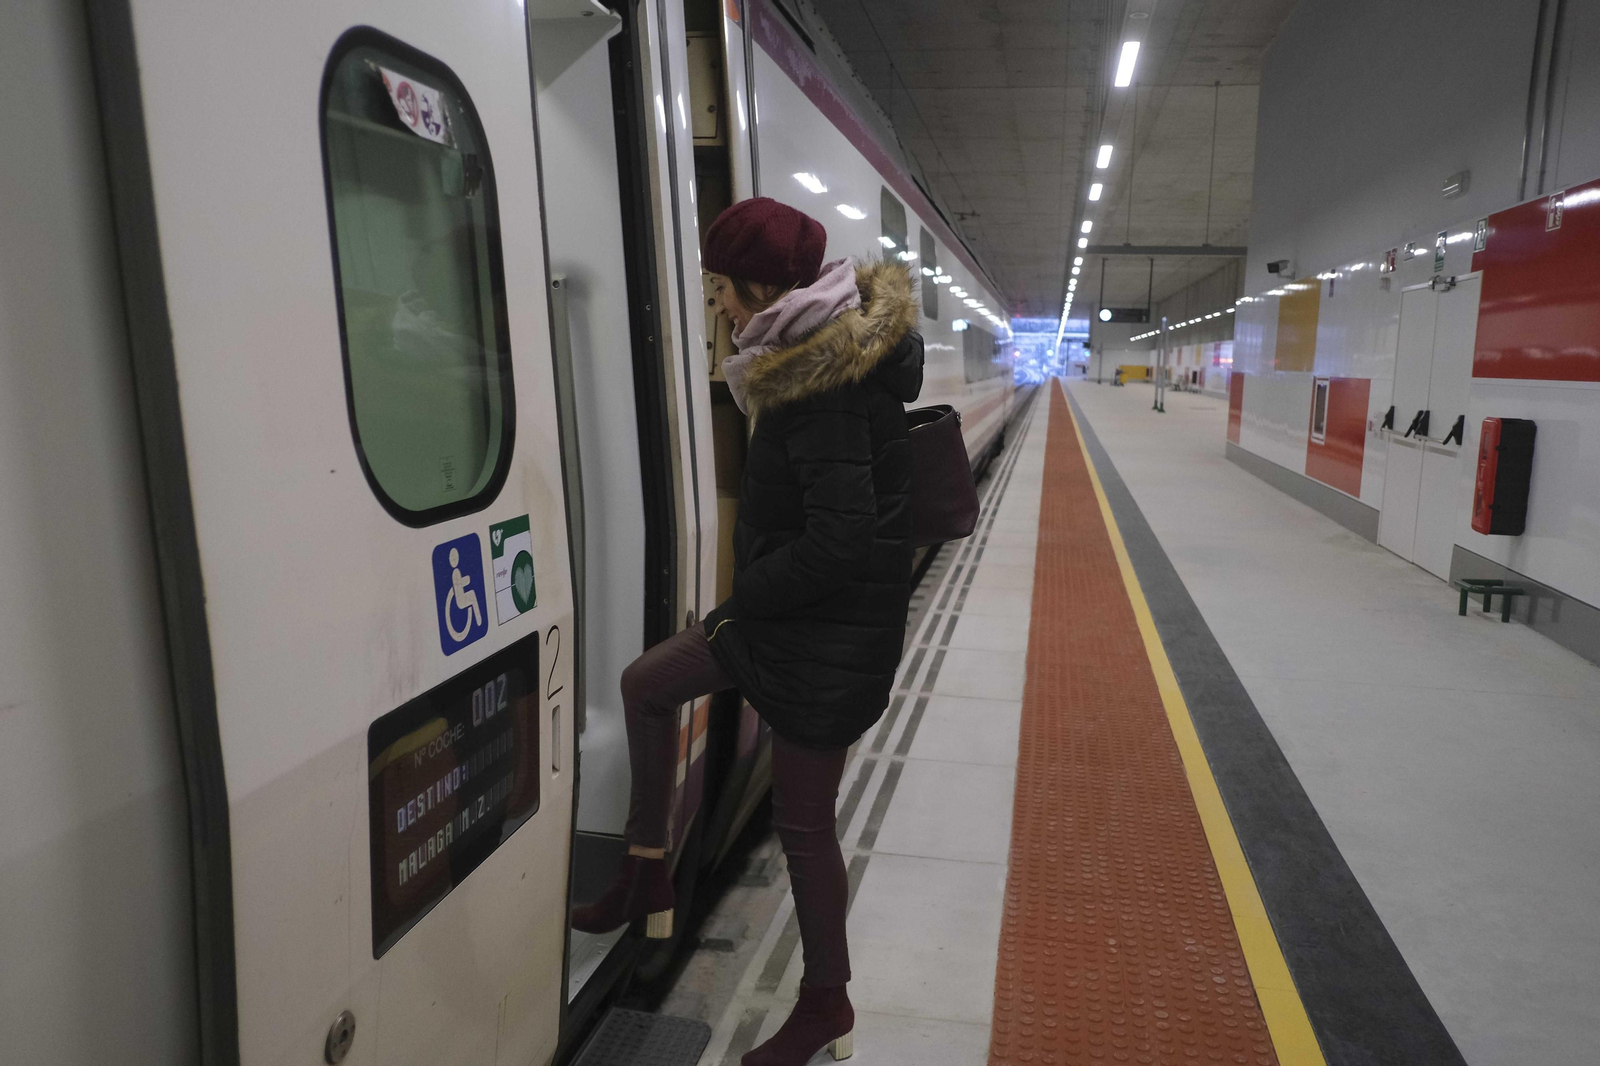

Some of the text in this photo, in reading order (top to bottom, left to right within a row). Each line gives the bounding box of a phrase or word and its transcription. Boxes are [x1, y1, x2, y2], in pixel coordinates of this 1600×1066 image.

[545, 624, 563, 701] 2
[428, 722, 465, 758] COCHE:
[472, 673, 507, 727] 002
[397, 765, 466, 833] DESTINO:
[399, 821, 453, 886] MALAGA
